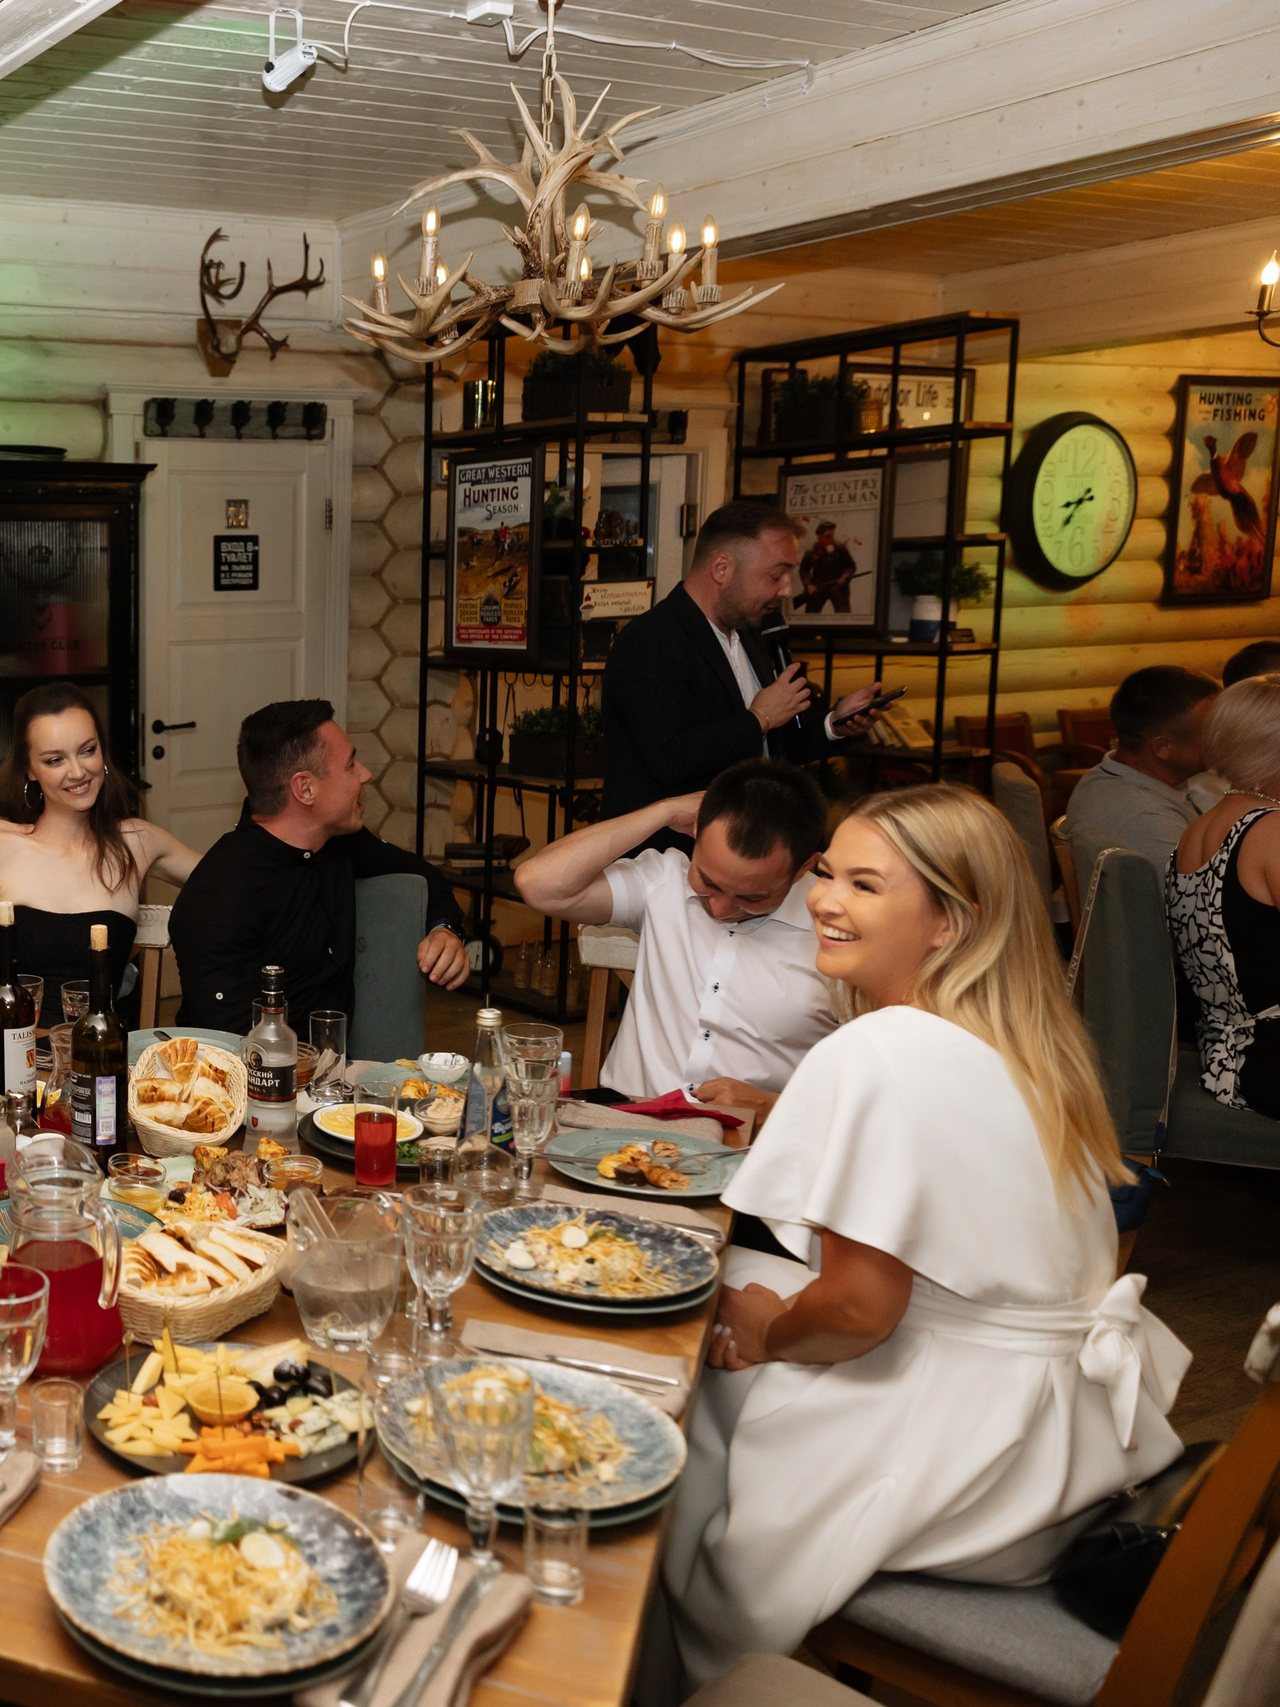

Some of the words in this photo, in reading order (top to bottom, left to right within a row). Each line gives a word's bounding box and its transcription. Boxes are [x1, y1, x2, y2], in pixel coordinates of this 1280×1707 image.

[1199, 392, 1253, 405] HUNTING
[1213, 408, 1266, 421] FISHING
[460, 468, 486, 481] GREAT
[487, 464, 529, 478] WESTERN
[791, 483, 809, 495] The
[813, 478, 878, 494] COUNTRY
[463, 486, 519, 508] HUNTING
[789, 490, 879, 507] GENTLEMAN
[220, 552, 254, 563] ТУАЛЕТ
[50, 639, 81, 650] CLUB
